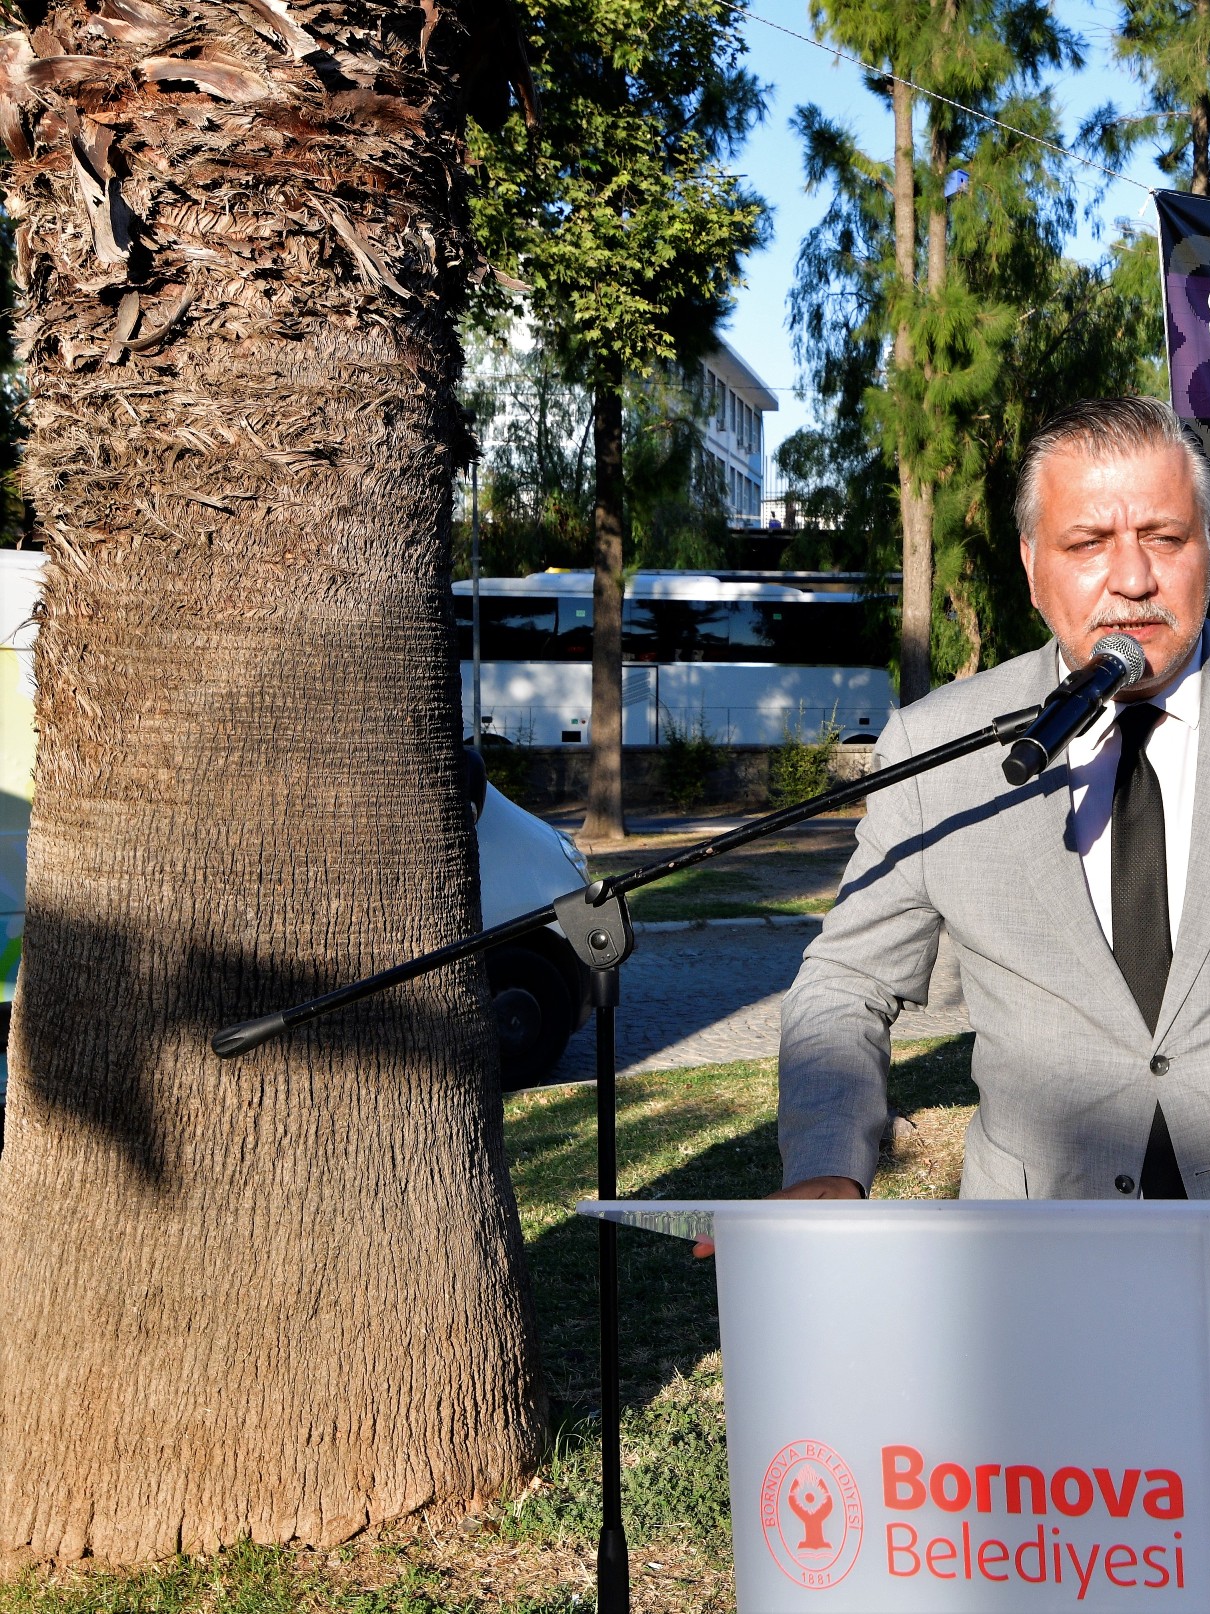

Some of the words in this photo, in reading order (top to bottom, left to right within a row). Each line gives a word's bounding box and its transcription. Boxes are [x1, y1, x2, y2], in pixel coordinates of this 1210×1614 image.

[763, 1448, 800, 1528] BORNOVA
[881, 1444, 1185, 1520] Bornova
[801, 1572, 831, 1585] 1881
[885, 1521, 1185, 1600] Belediyesi
